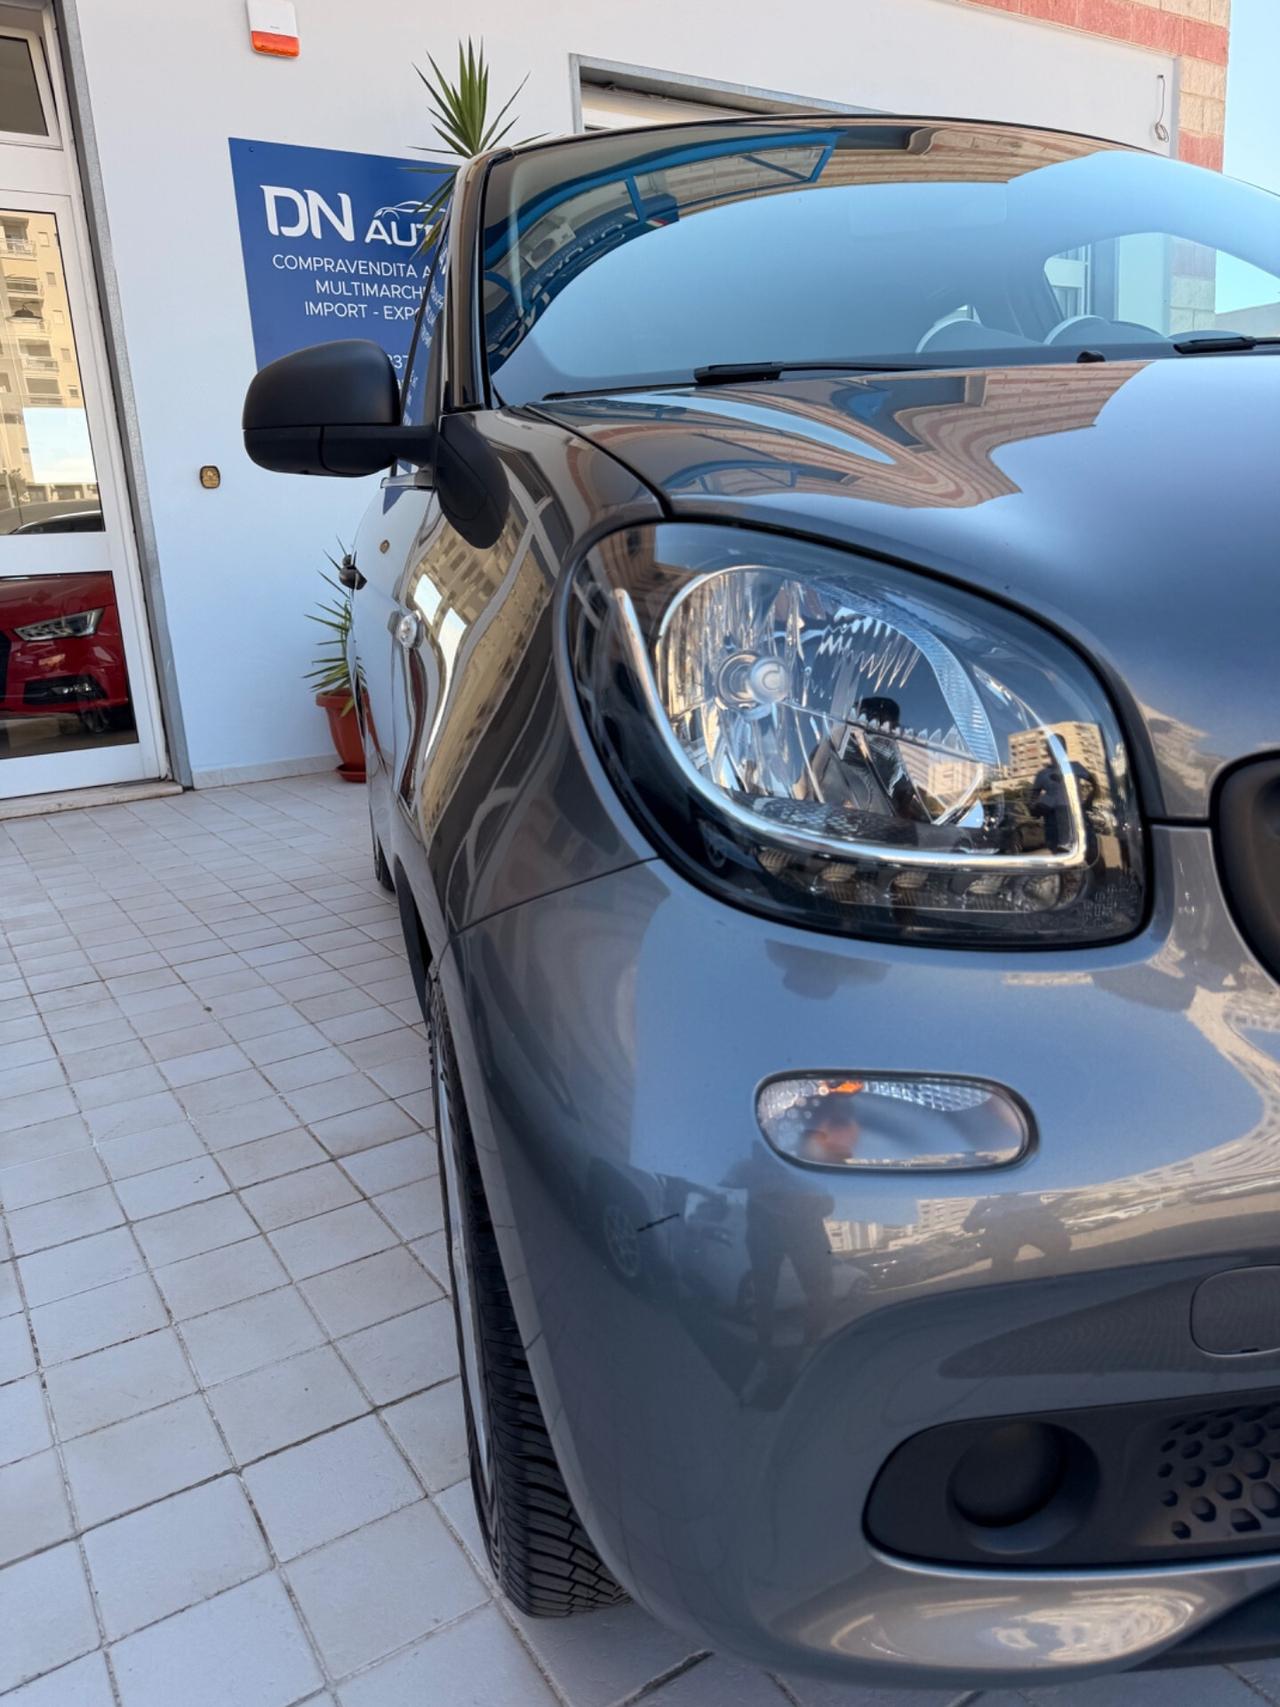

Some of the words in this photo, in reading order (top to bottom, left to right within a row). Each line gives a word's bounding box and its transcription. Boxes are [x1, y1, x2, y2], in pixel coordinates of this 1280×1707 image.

[260, 184, 355, 241] DN
[272, 254, 418, 279] COMPRAVENDITA
[304, 301, 368, 319] IMPORT
